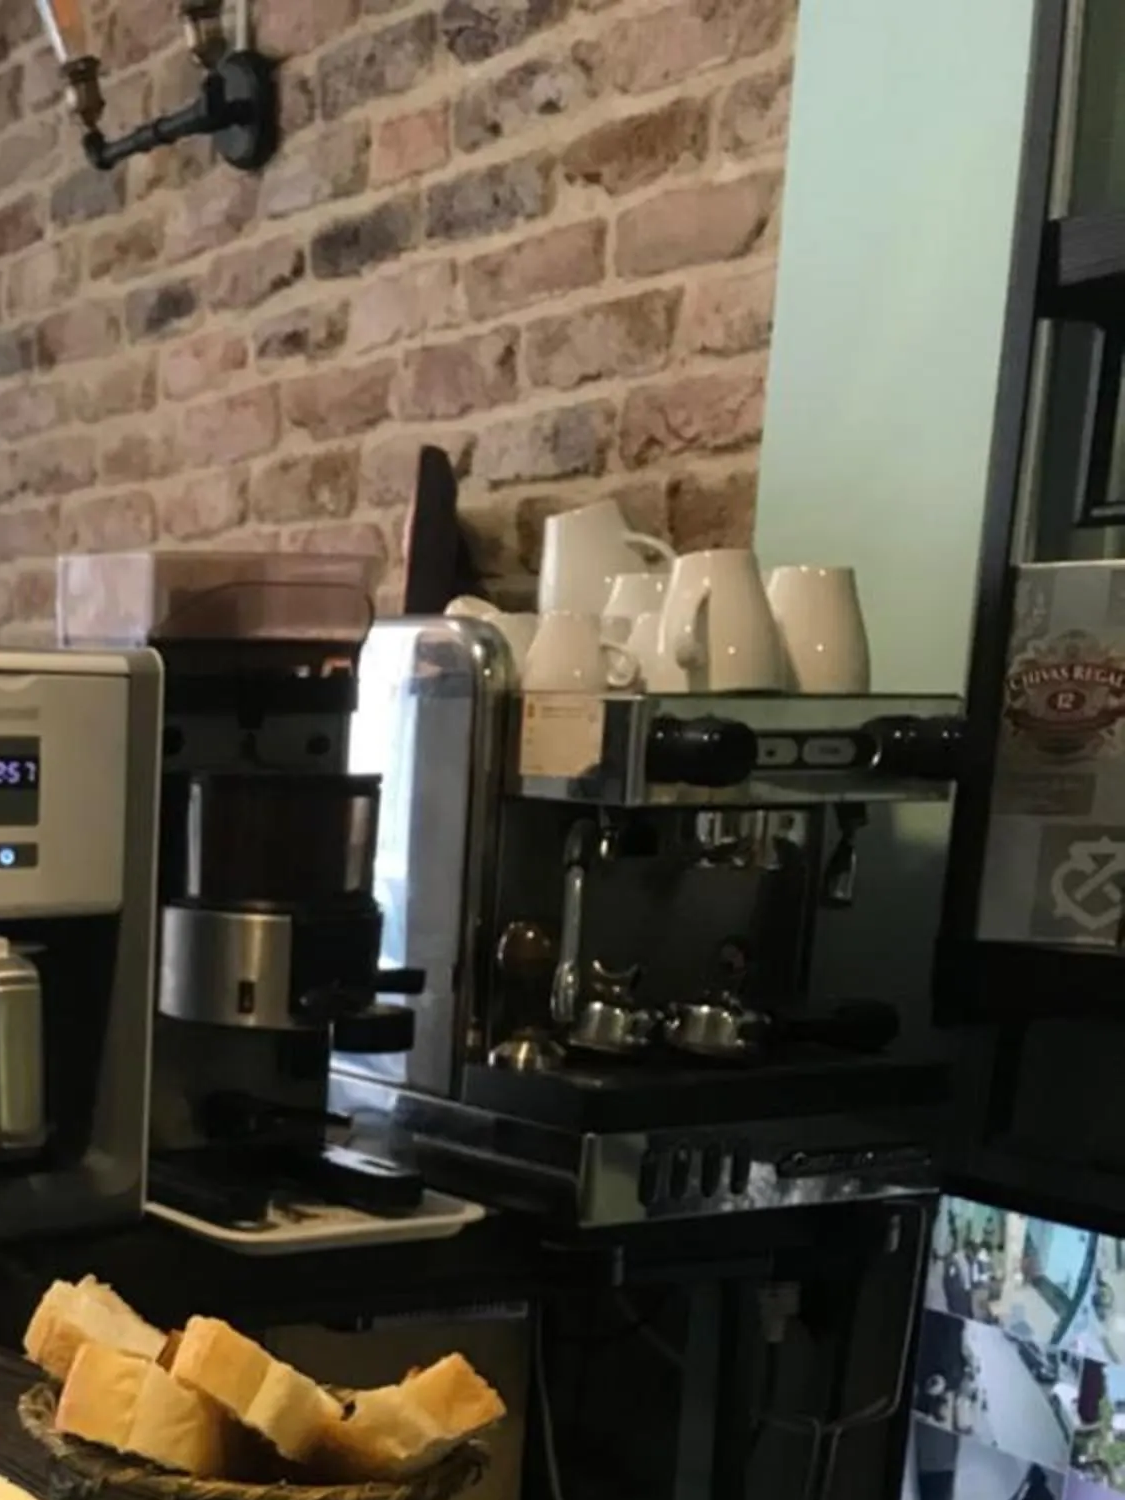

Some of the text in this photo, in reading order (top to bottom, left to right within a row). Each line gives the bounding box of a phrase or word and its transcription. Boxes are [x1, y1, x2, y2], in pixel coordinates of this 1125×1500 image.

[1009, 665, 1124, 691] CHIVAS REGAL
[1056, 693, 1075, 710] 12
